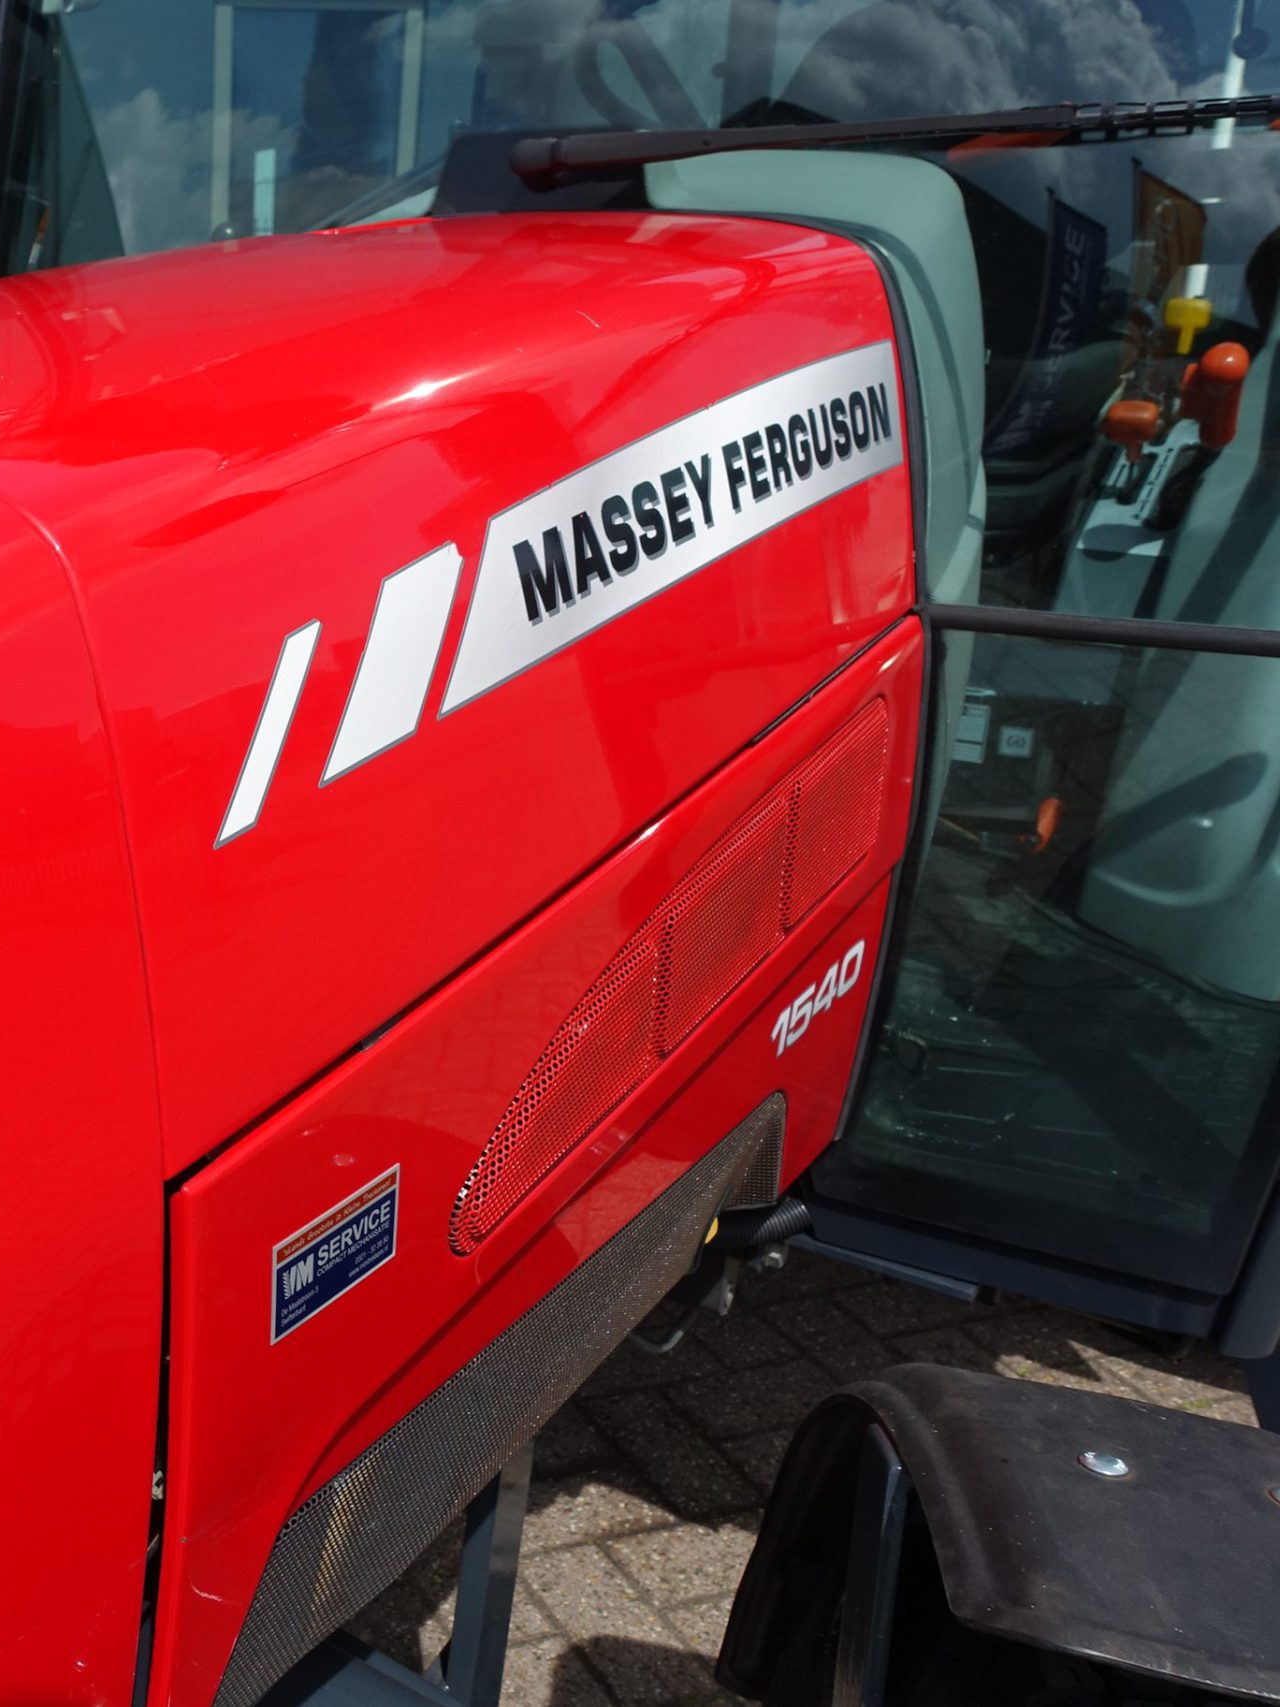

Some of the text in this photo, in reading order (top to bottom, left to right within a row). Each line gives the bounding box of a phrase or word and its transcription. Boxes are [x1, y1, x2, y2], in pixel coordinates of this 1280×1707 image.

[513, 382, 892, 626] MASSEY FERGUSON
[770, 938, 866, 1059] 1540
[316, 1253, 347, 1278] COMPACT
[347, 1221, 390, 1258] MECHANISATIE
[317, 1200, 391, 1267] SERVICE
